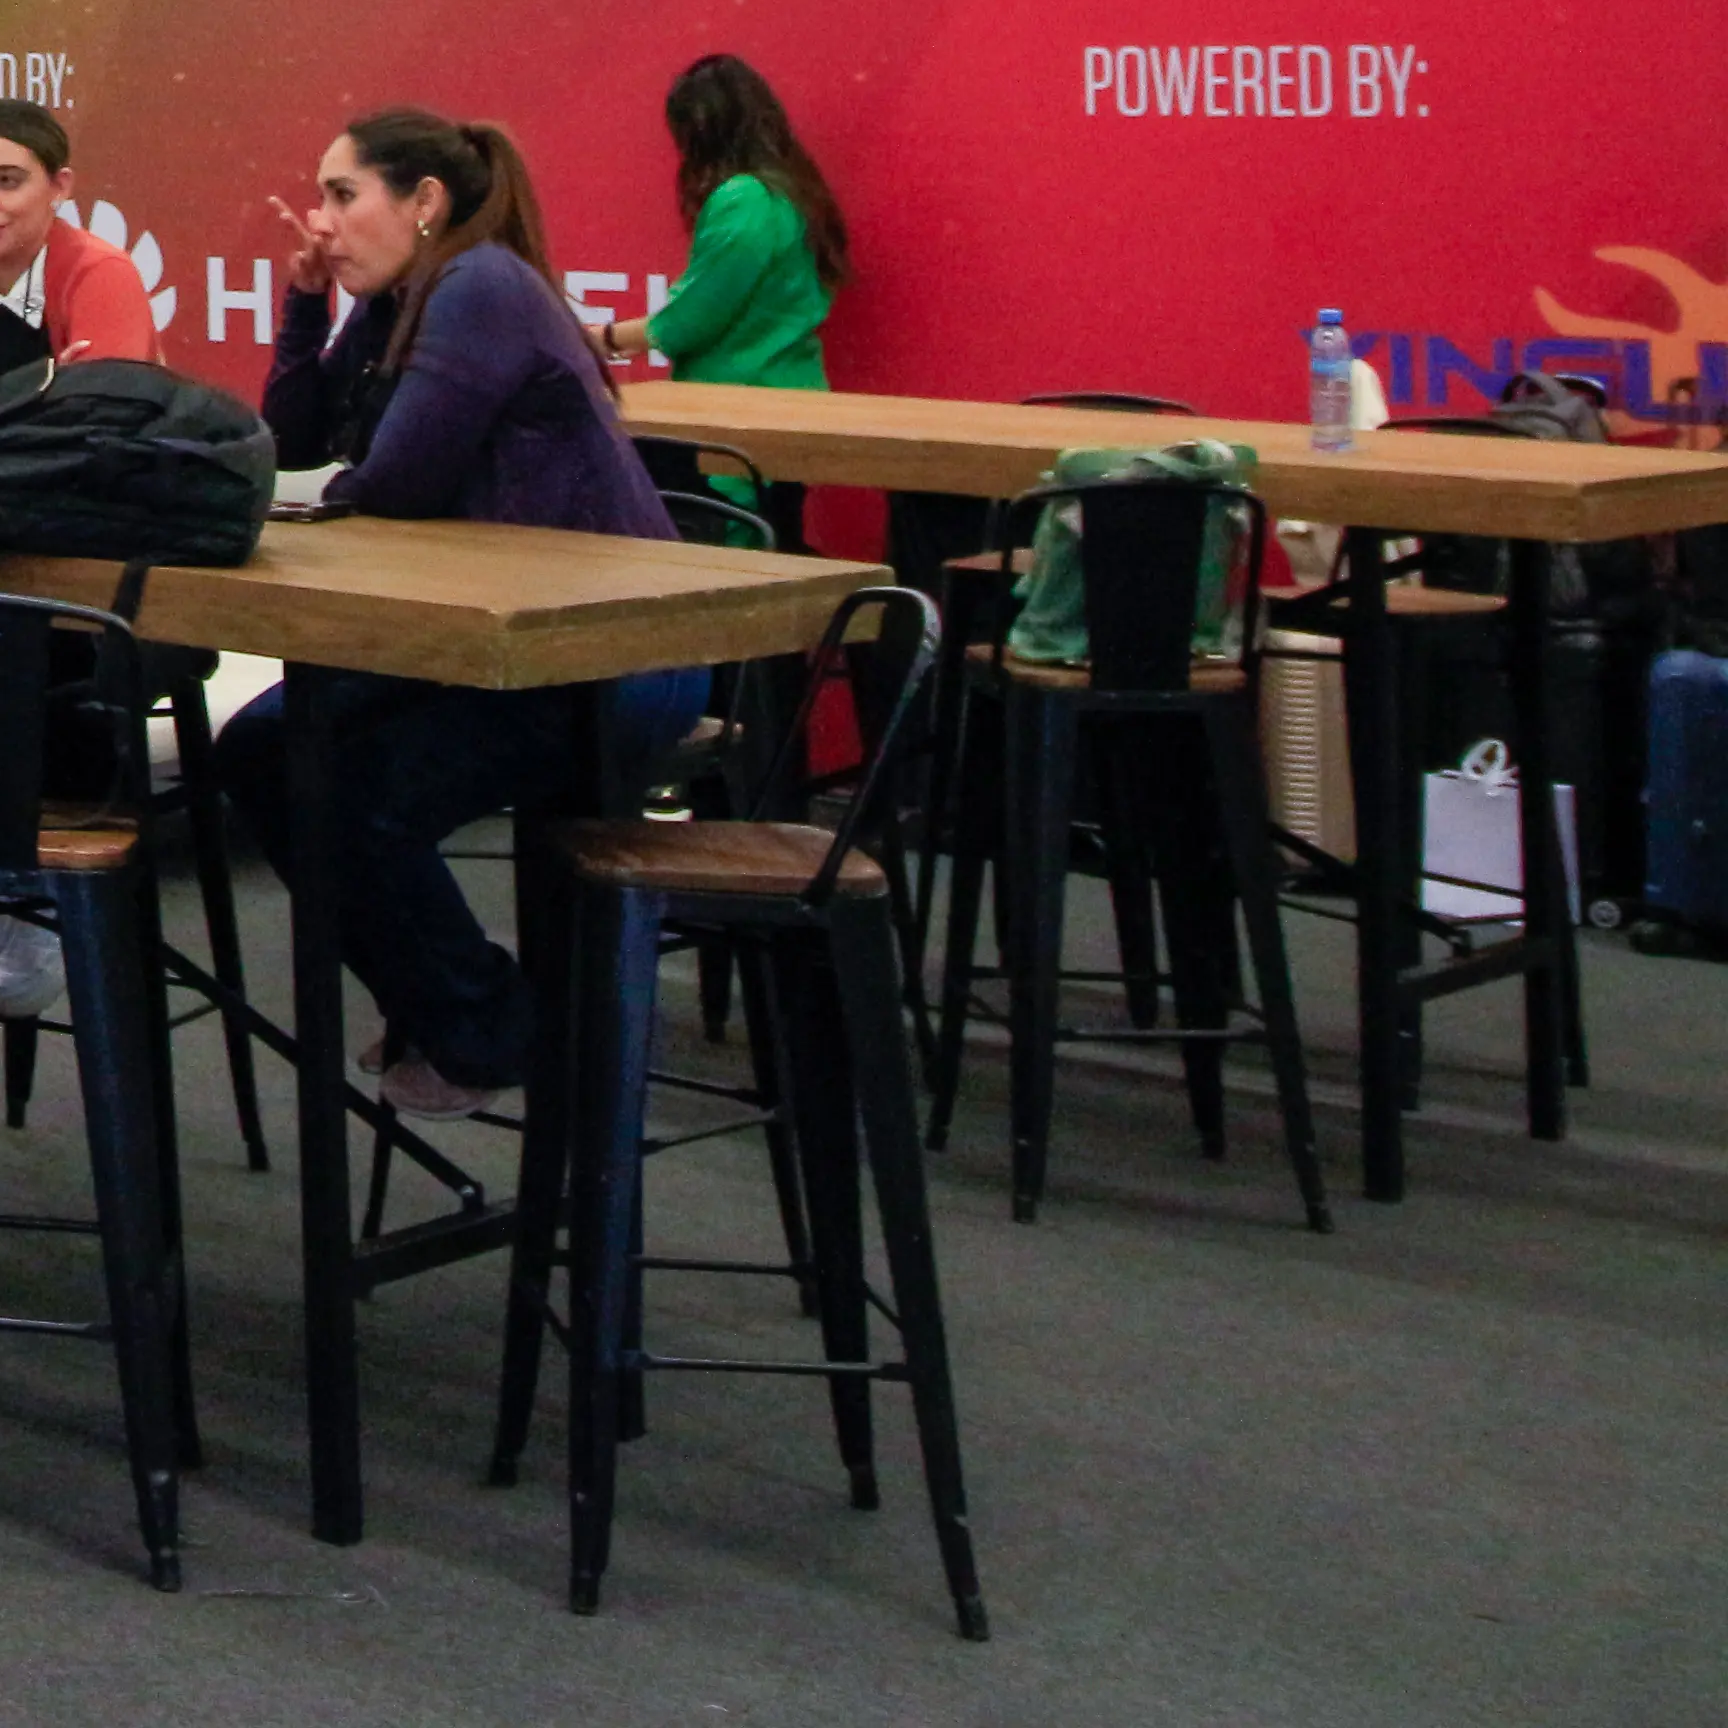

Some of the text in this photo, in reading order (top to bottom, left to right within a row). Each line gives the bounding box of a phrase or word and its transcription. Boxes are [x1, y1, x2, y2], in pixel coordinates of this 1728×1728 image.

[25, 52, 74, 109] BY:
[1084, 43, 1429, 118] POWERED BY:
